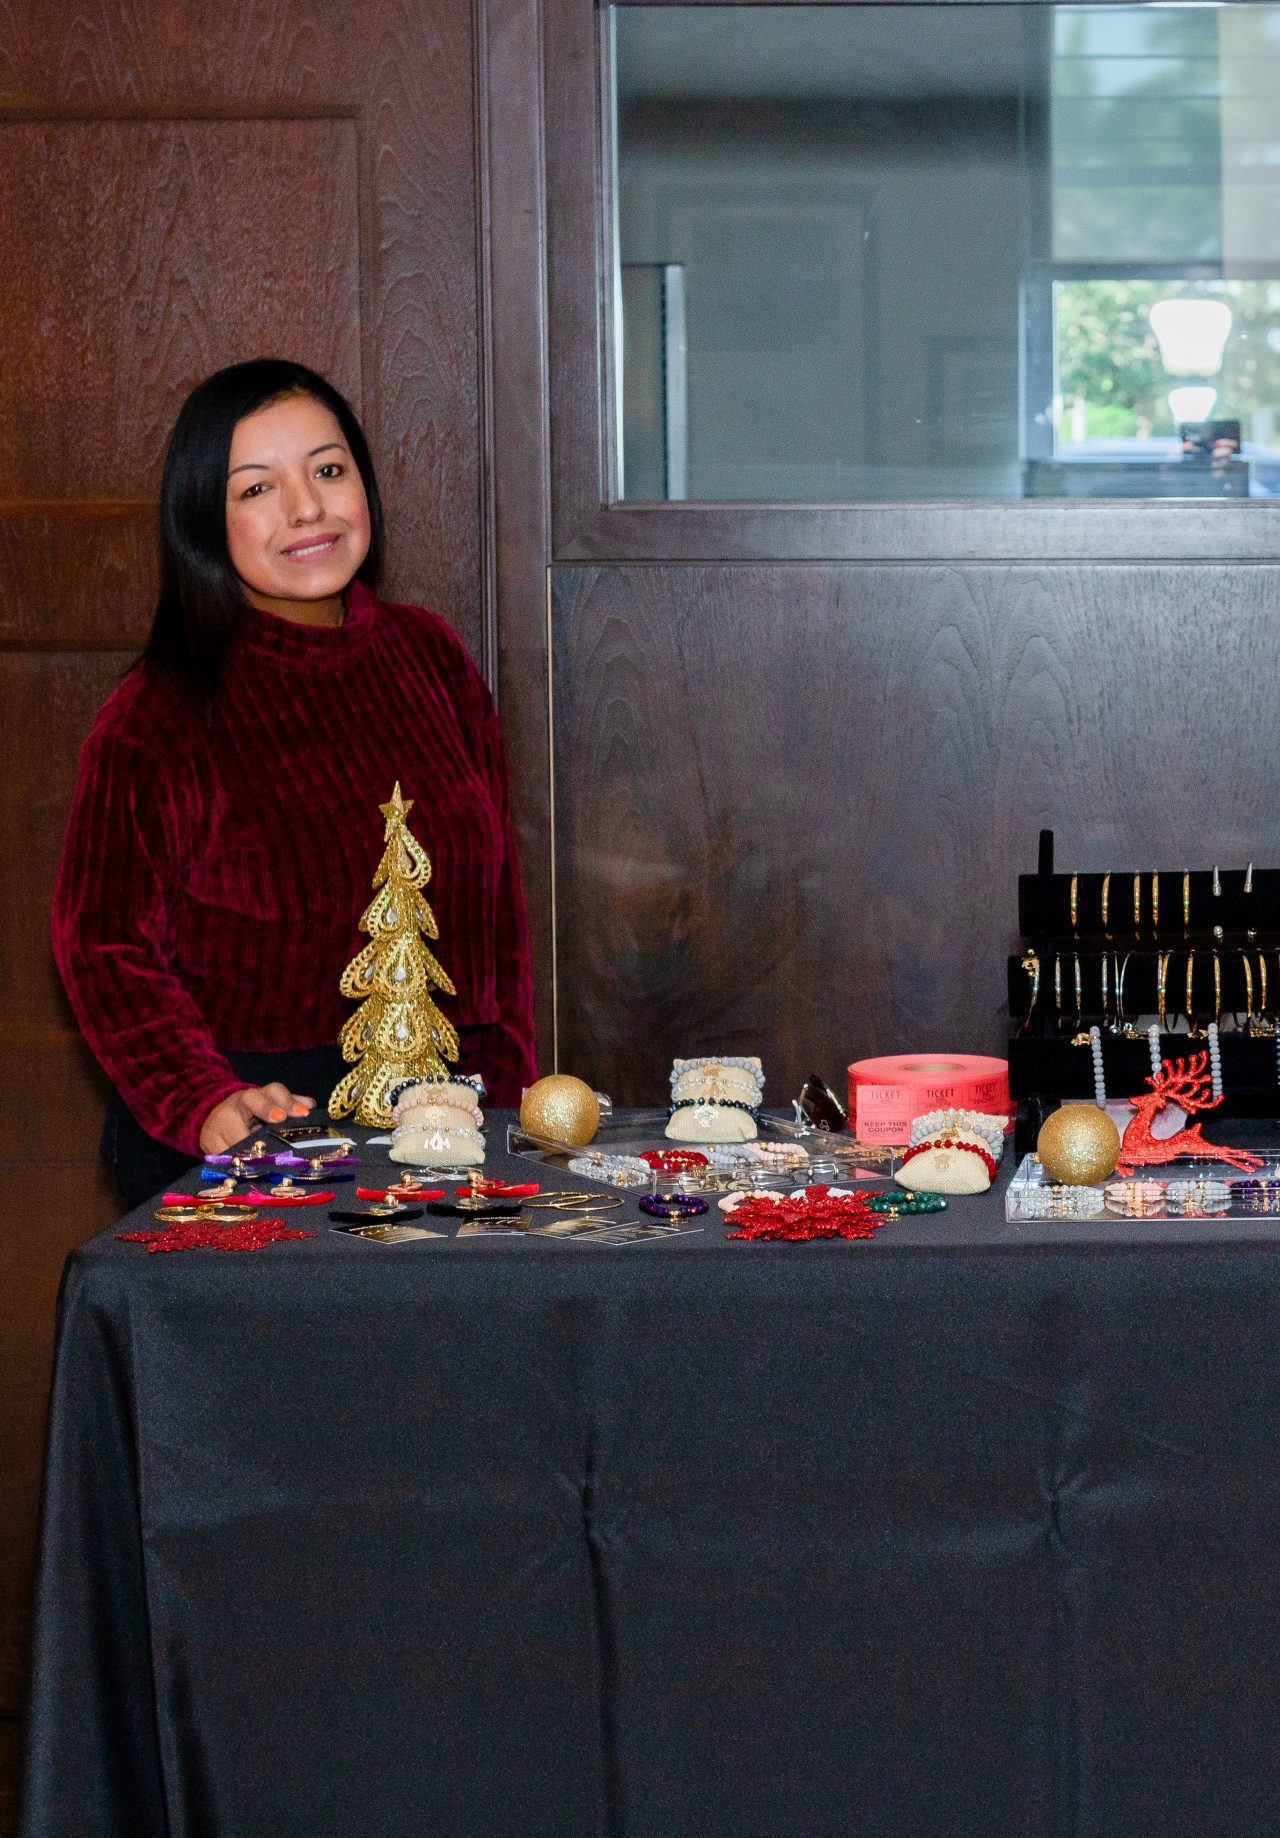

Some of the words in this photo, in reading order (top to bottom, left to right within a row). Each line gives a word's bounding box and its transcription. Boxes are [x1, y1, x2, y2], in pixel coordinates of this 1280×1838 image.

[926, 1088, 955, 1098] TICKET
[974, 1083, 996, 1095] TICKET
[870, 1090, 900, 1099] TICKET
